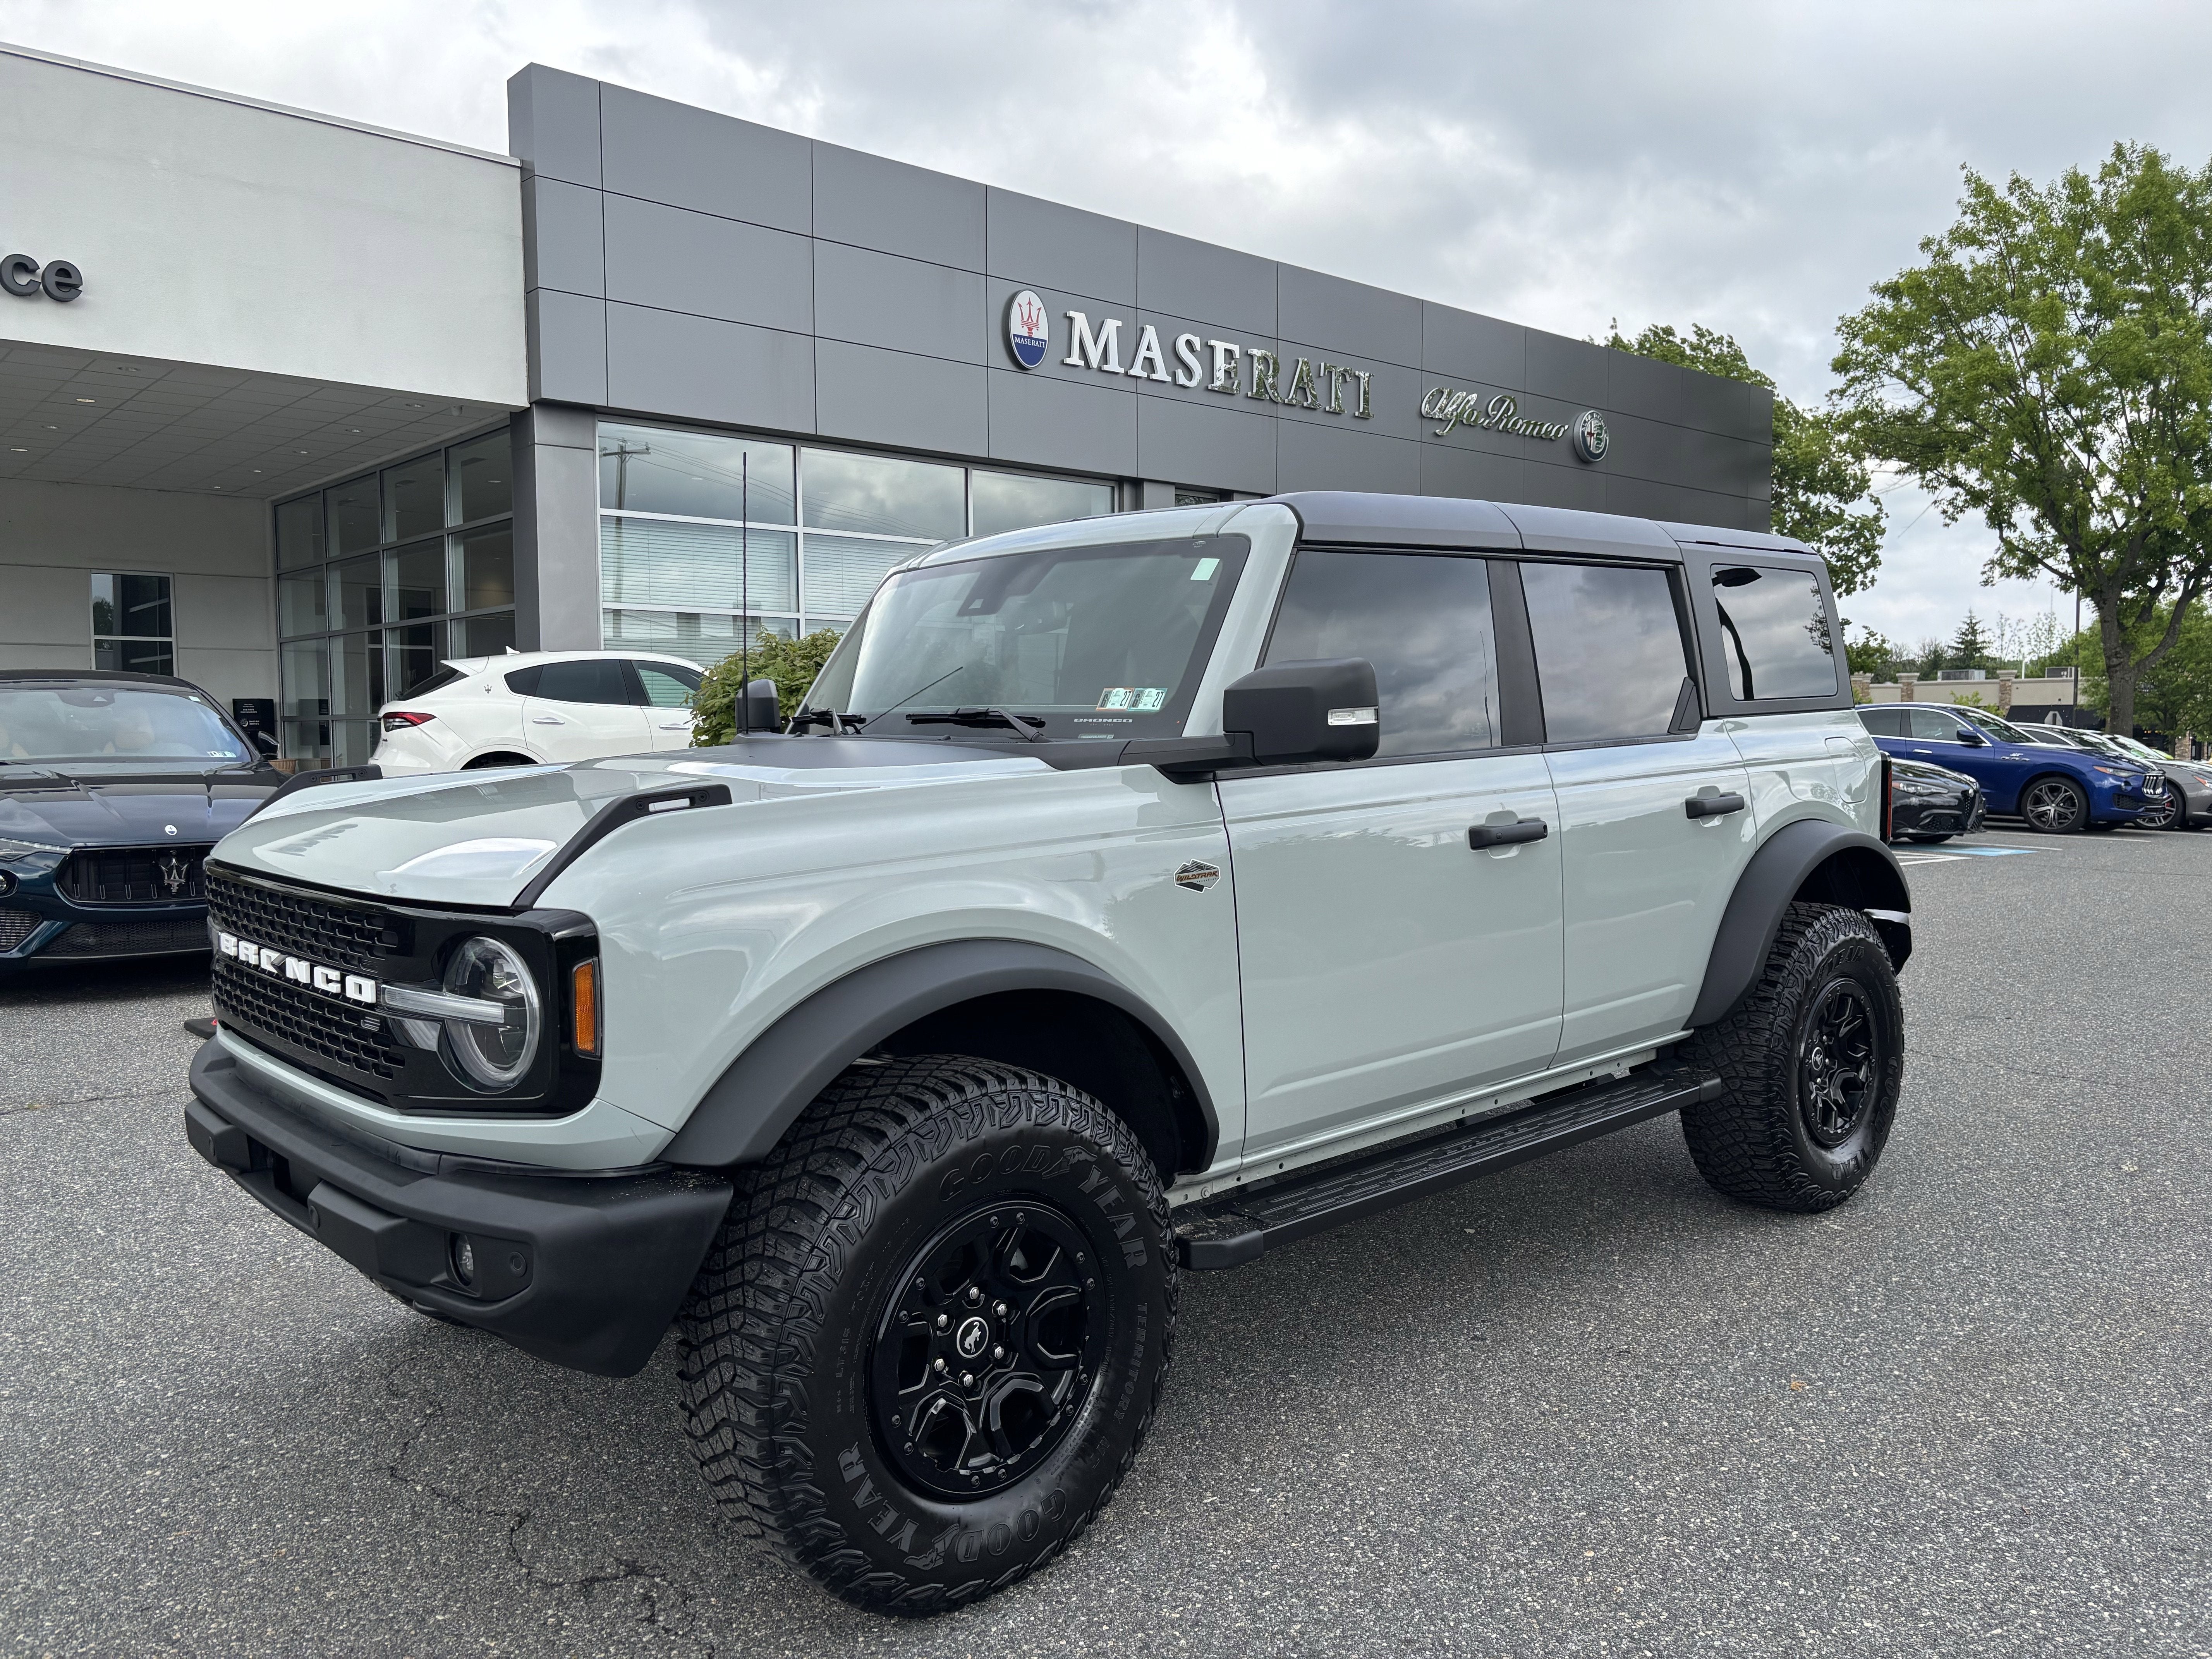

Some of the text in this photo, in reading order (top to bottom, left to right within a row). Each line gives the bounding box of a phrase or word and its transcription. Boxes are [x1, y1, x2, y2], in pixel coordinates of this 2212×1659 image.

[0, 254, 83, 302] ce
[1014, 336, 1045, 348] MASERATI
[1063, 310, 1375, 419] MASERATI
[1421, 387, 1569, 440] Alfa Romeo
[1120, 690, 1132, 708] 27
[1152, 691, 1164, 708] 27
[1176, 870, 1218, 882] WILDTRAK
[219, 931, 376, 1004] BRONCO
[1113, 1302, 1148, 1424] TERRITORY
